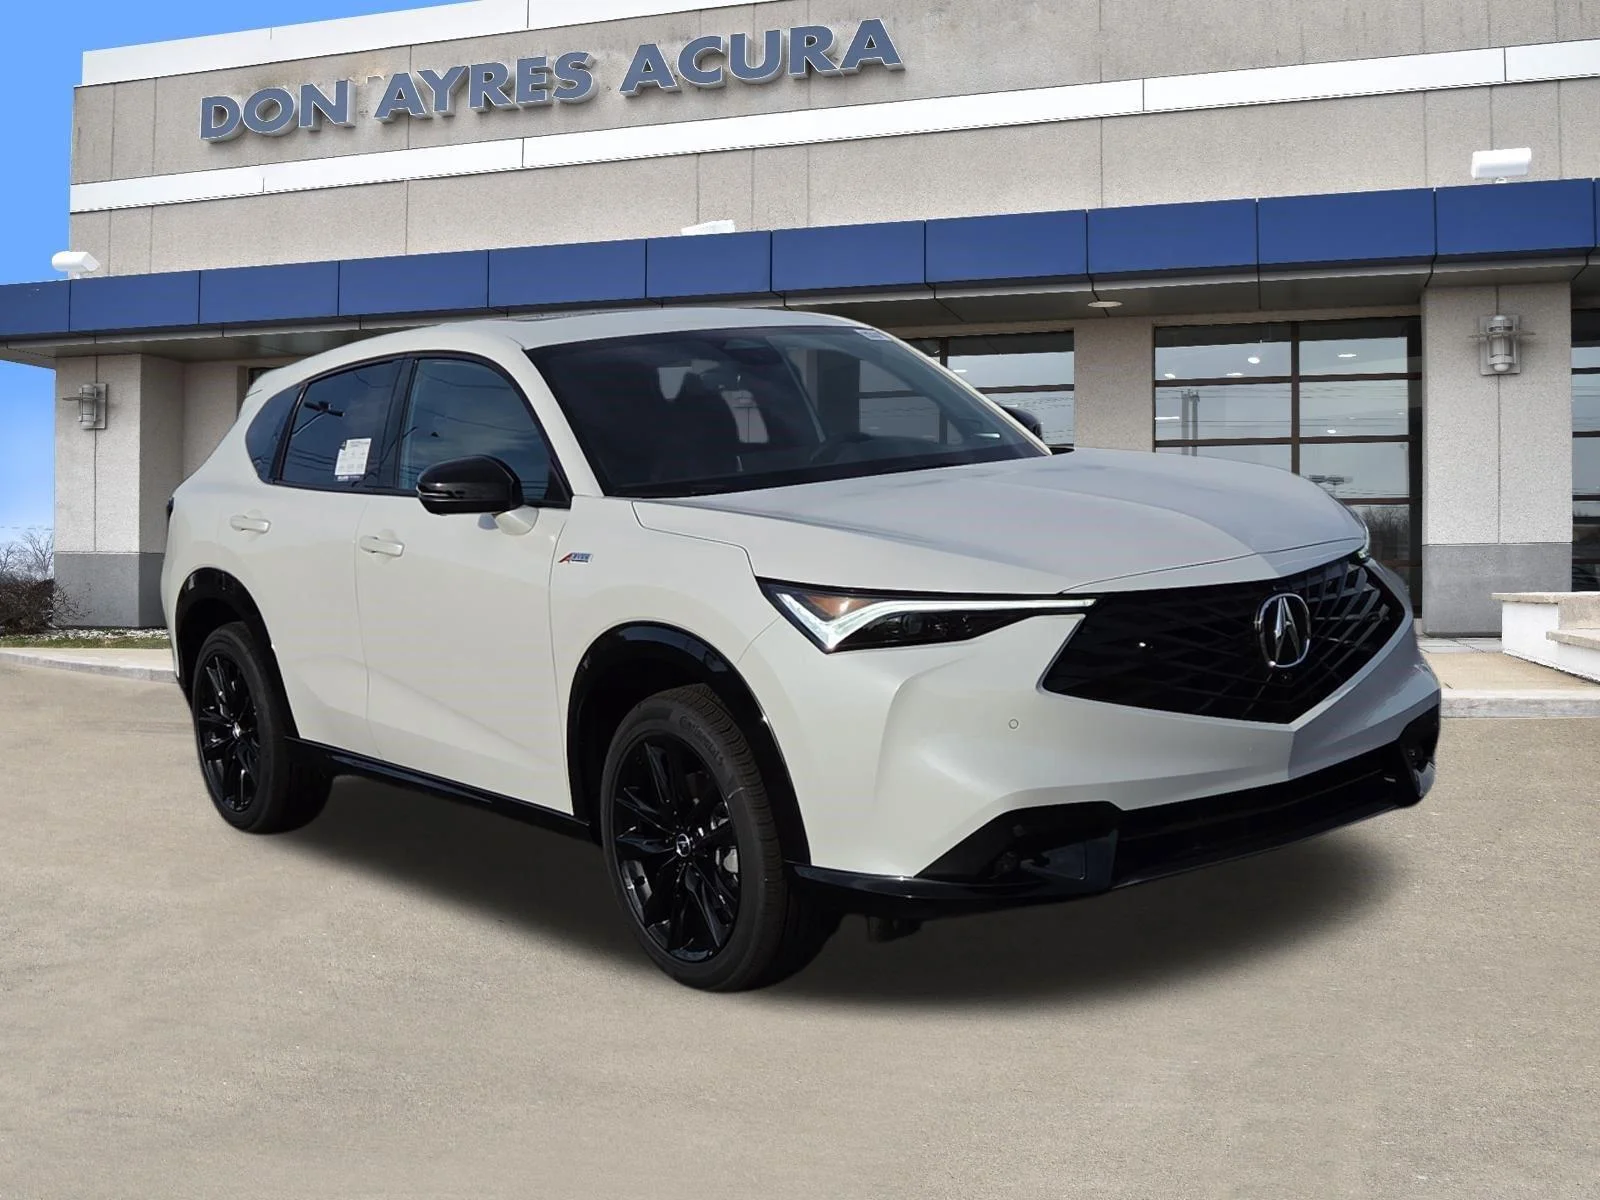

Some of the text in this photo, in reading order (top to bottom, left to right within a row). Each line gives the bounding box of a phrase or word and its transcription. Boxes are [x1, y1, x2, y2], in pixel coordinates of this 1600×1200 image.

[199, 17, 904, 142] DON AYRES ACURA
